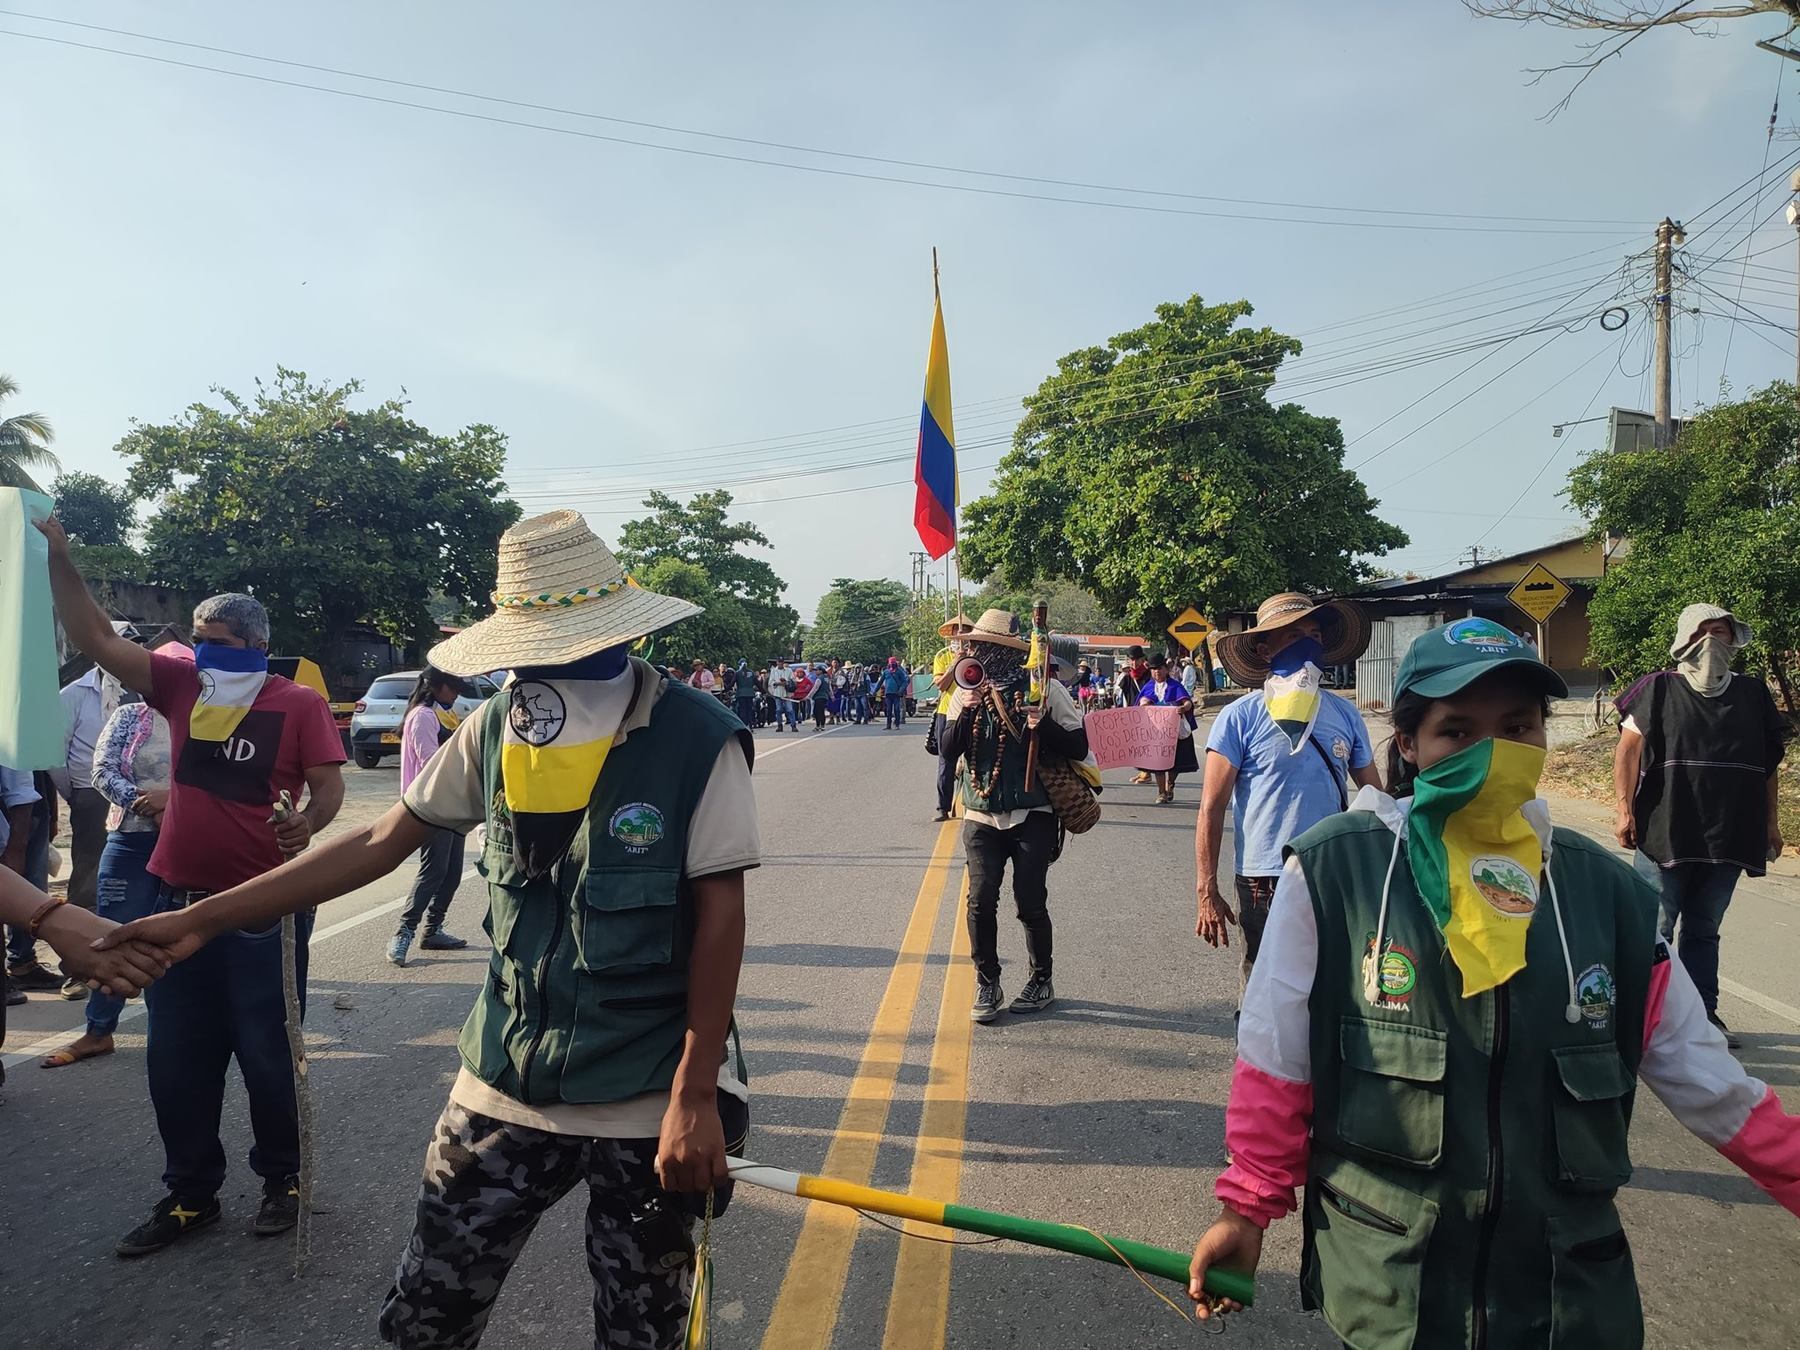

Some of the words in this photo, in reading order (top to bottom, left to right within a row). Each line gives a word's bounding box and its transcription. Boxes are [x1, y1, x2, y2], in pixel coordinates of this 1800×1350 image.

[1092, 710, 1141, 734] RESPETO
[1147, 709, 1172, 727] POR
[1099, 732, 1121, 751] LOS
[1095, 752, 1109, 766] DE
[1112, 750, 1126, 762] LA
[1128, 745, 1152, 758] MADRE
